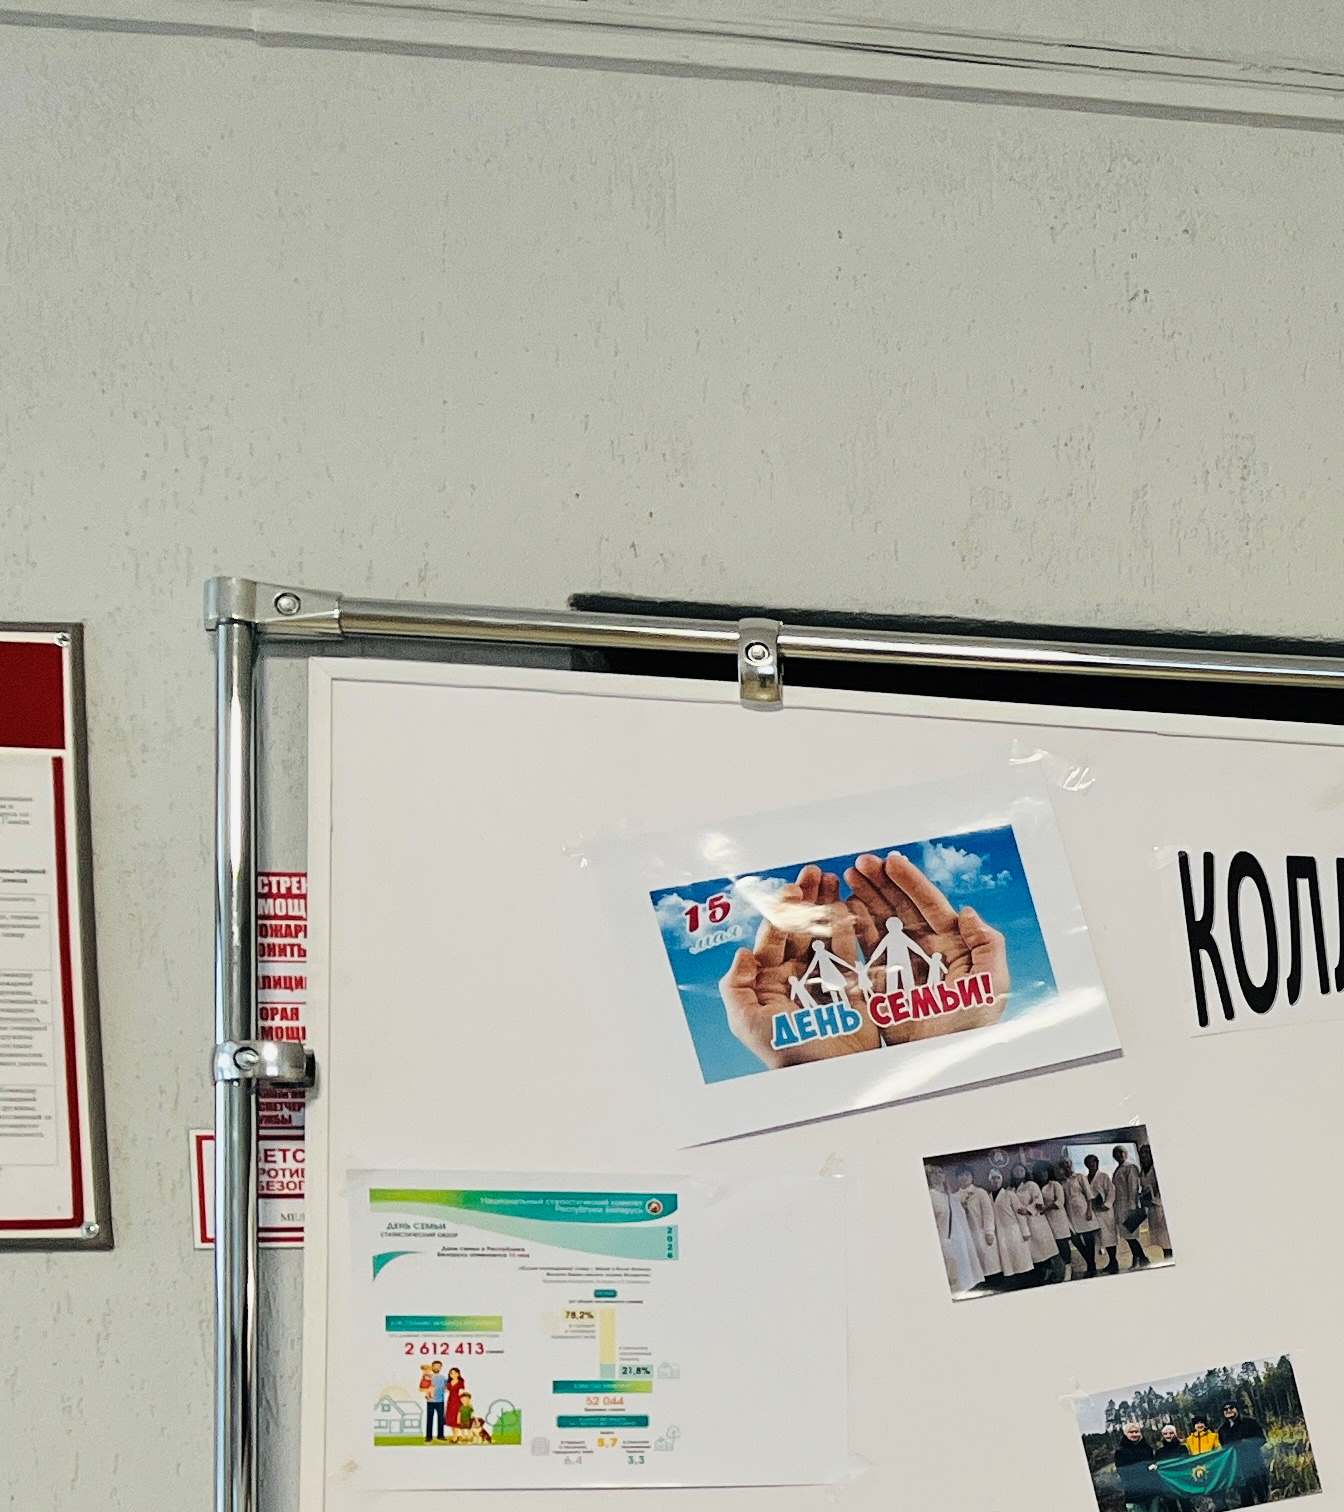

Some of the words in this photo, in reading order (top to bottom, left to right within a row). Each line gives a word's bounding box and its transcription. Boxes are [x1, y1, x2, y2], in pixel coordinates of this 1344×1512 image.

[683, 894, 732, 933] 15
[258, 976, 306, 991] ЛИЦИ
[771, 1001, 863, 1050] ДЕНЬ
[866, 972, 995, 1028] СЕМЬИ!
[258, 1149, 305, 1163] ЕТС
[405, 1342, 414, 1355] 2
[420, 1342, 449, 1355] 612
[455, 1342, 484, 1355] 413
